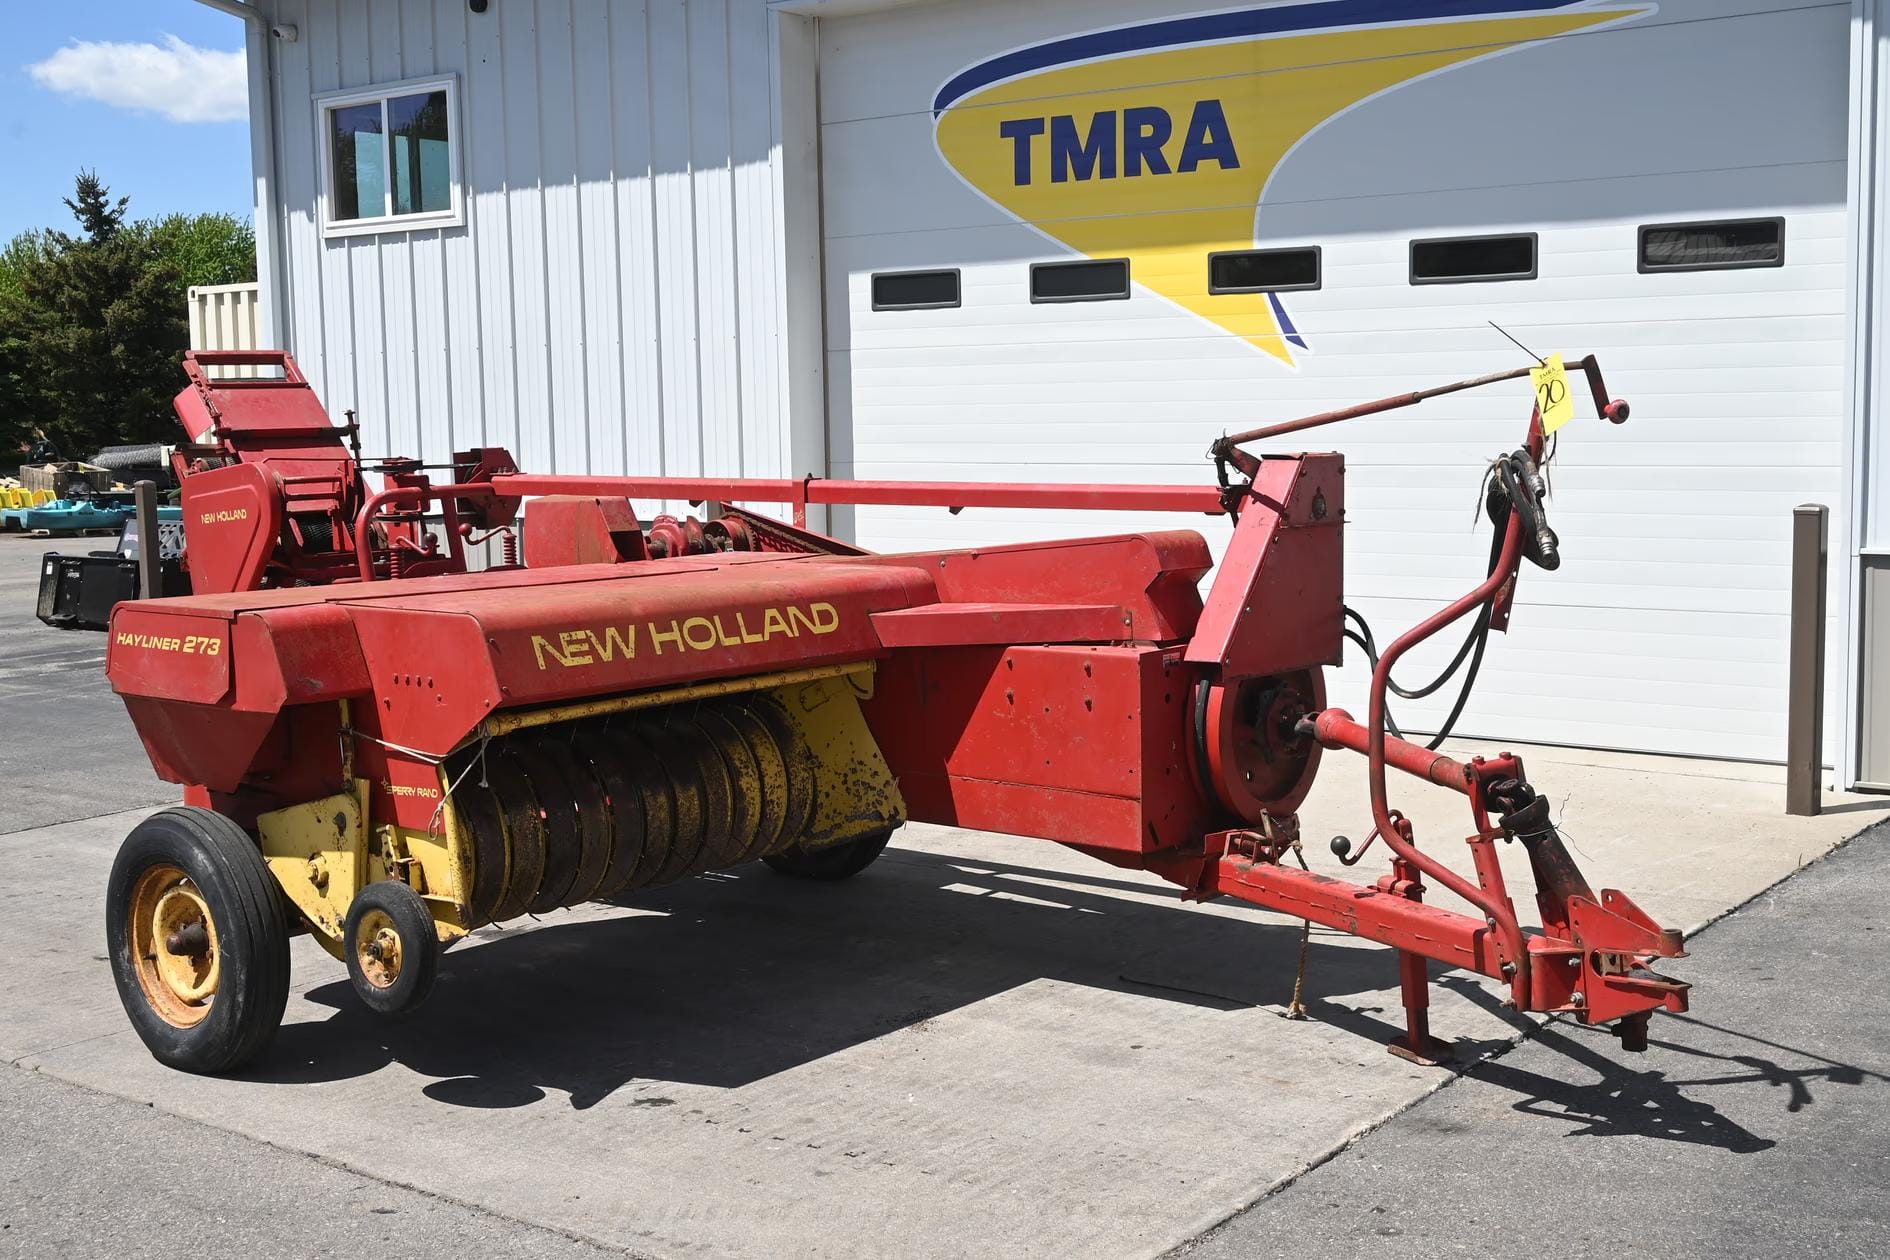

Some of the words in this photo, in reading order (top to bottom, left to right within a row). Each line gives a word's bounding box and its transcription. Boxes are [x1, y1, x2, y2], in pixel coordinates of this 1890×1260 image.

[1000, 99, 1240, 186] TMRA
[1538, 379, 1565, 414] 20
[200, 512, 216, 525] NEW
[216, 508, 247, 522] HOLLAND
[116, 632, 181, 652] HAYLINER
[182, 635, 221, 656] 273
[531, 625, 635, 670] NEW
[648, 602, 839, 655] HOLLAND
[386, 785, 416, 797] SPERRY
[416, 787, 439, 799] RAND
